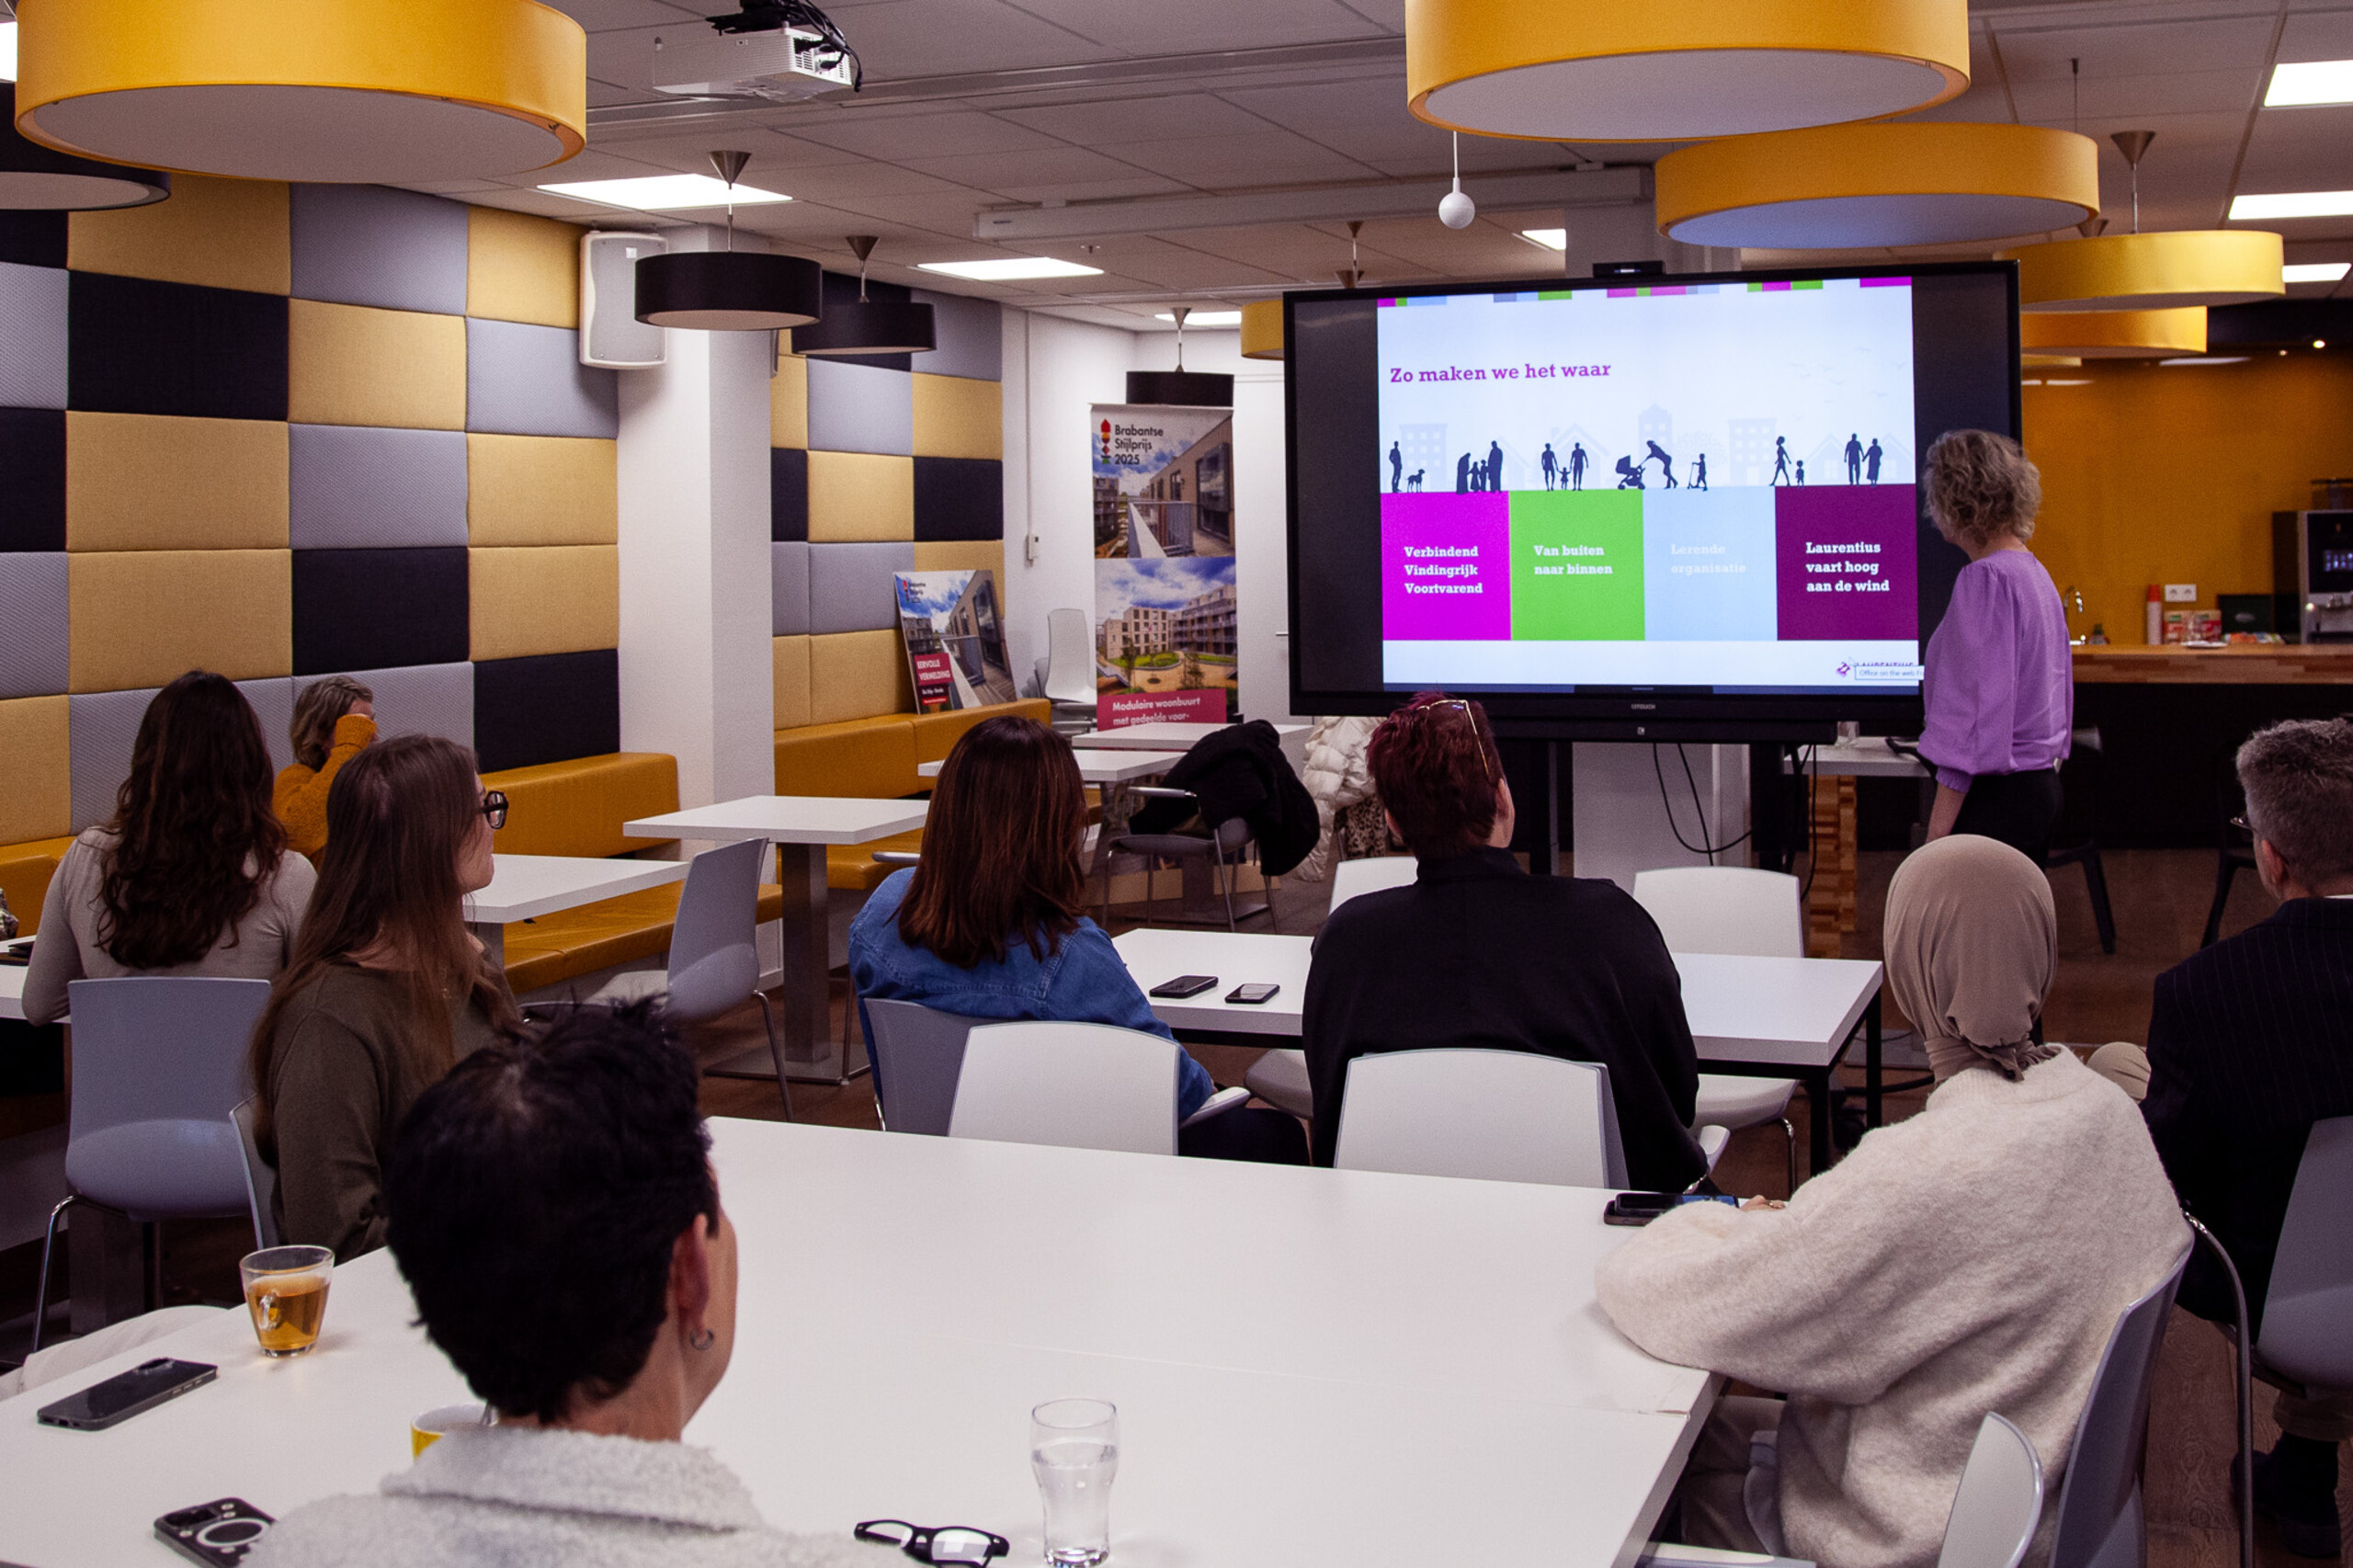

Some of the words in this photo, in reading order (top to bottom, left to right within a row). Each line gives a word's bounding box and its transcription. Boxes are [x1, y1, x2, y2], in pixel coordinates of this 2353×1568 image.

[1391, 368, 1414, 382] Zo
[1418, 366, 1487, 382] maken
[1492, 368, 1519, 380] we
[1525, 364, 1556, 379] het
[1561, 364, 1612, 378] waar
[1115, 424, 1164, 437] Brabantse
[1114, 437, 1153, 452] Stijlprijs
[1114, 454, 1140, 465] 2025
[1404, 546, 1479, 558] Verbindend
[1533, 545, 1560, 556] Van
[1562, 545, 1605, 556] buiten
[1670, 543, 1726, 555] Lerende
[1805, 541, 1881, 553] Laurentius
[1404, 564, 1479, 578] Vindingrijk
[1534, 564, 1564, 574] naar
[1566, 563, 1613, 574] binnen
[1670, 562, 1747, 576] organisatie
[1805, 562, 1842, 573] vaart
[1844, 561, 1880, 575] hoog
[1404, 583, 1483, 594] Voortvarend
[1806, 581, 1832, 592] aan
[1835, 580, 1852, 592] de
[1854, 579, 1890, 592] wind
[1112, 699, 1154, 711] Modulaire
[1155, 697, 1201, 708] woonbuurt
[1112, 717, 1130, 726] met
[1130, 712, 1167, 725] gedeelde
[1168, 713, 1190, 722] voor-
